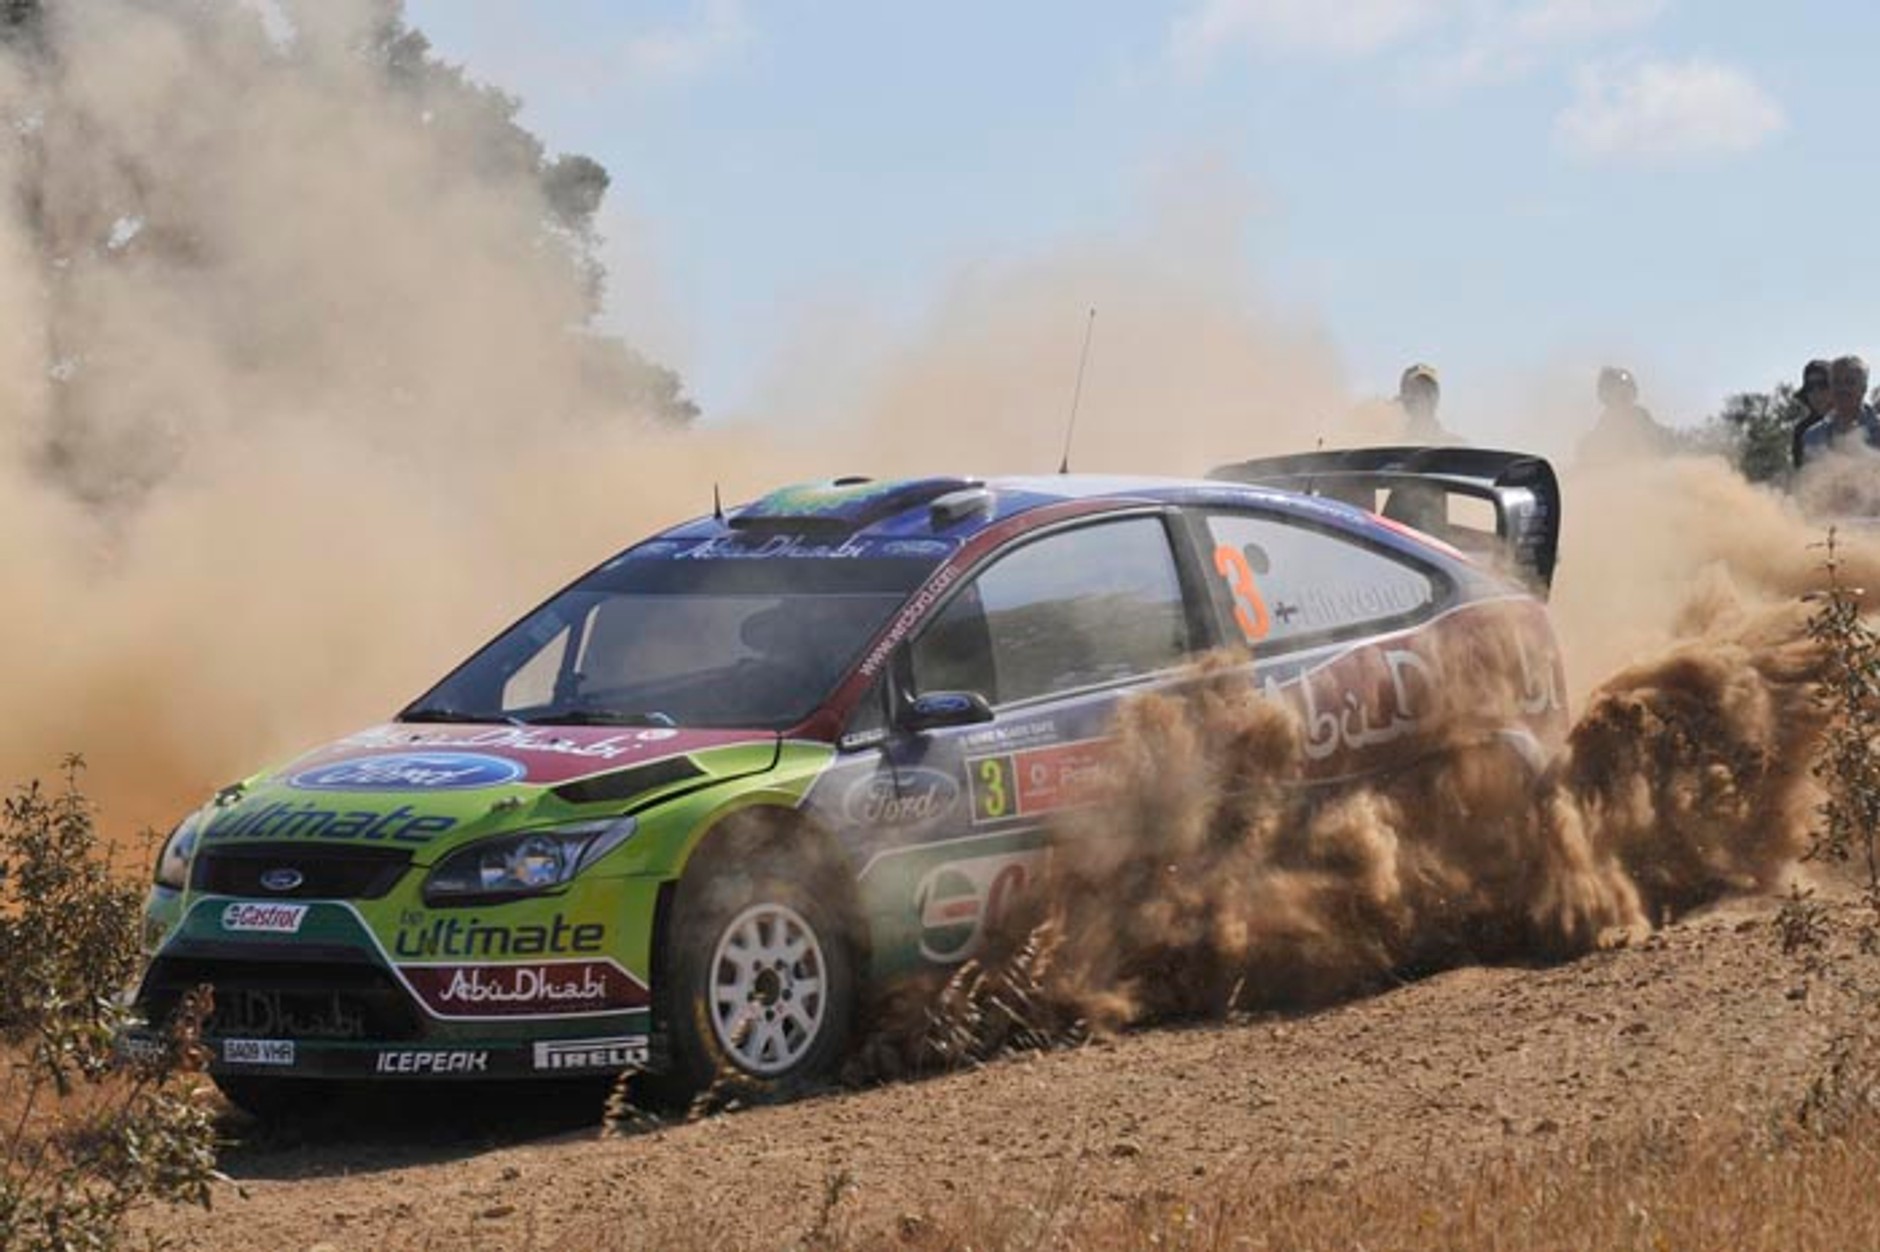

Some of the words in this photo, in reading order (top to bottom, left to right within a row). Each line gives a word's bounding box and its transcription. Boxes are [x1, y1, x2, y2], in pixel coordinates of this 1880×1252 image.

[1214, 543, 1270, 641] 3
[864, 776, 940, 822] Ford
[979, 757, 1006, 817] 3
[203, 802, 457, 842] ultimate
[239, 904, 302, 928] Castrol
[395, 912, 605, 957] ultimate
[376, 1052, 489, 1073] ICEPEAK
